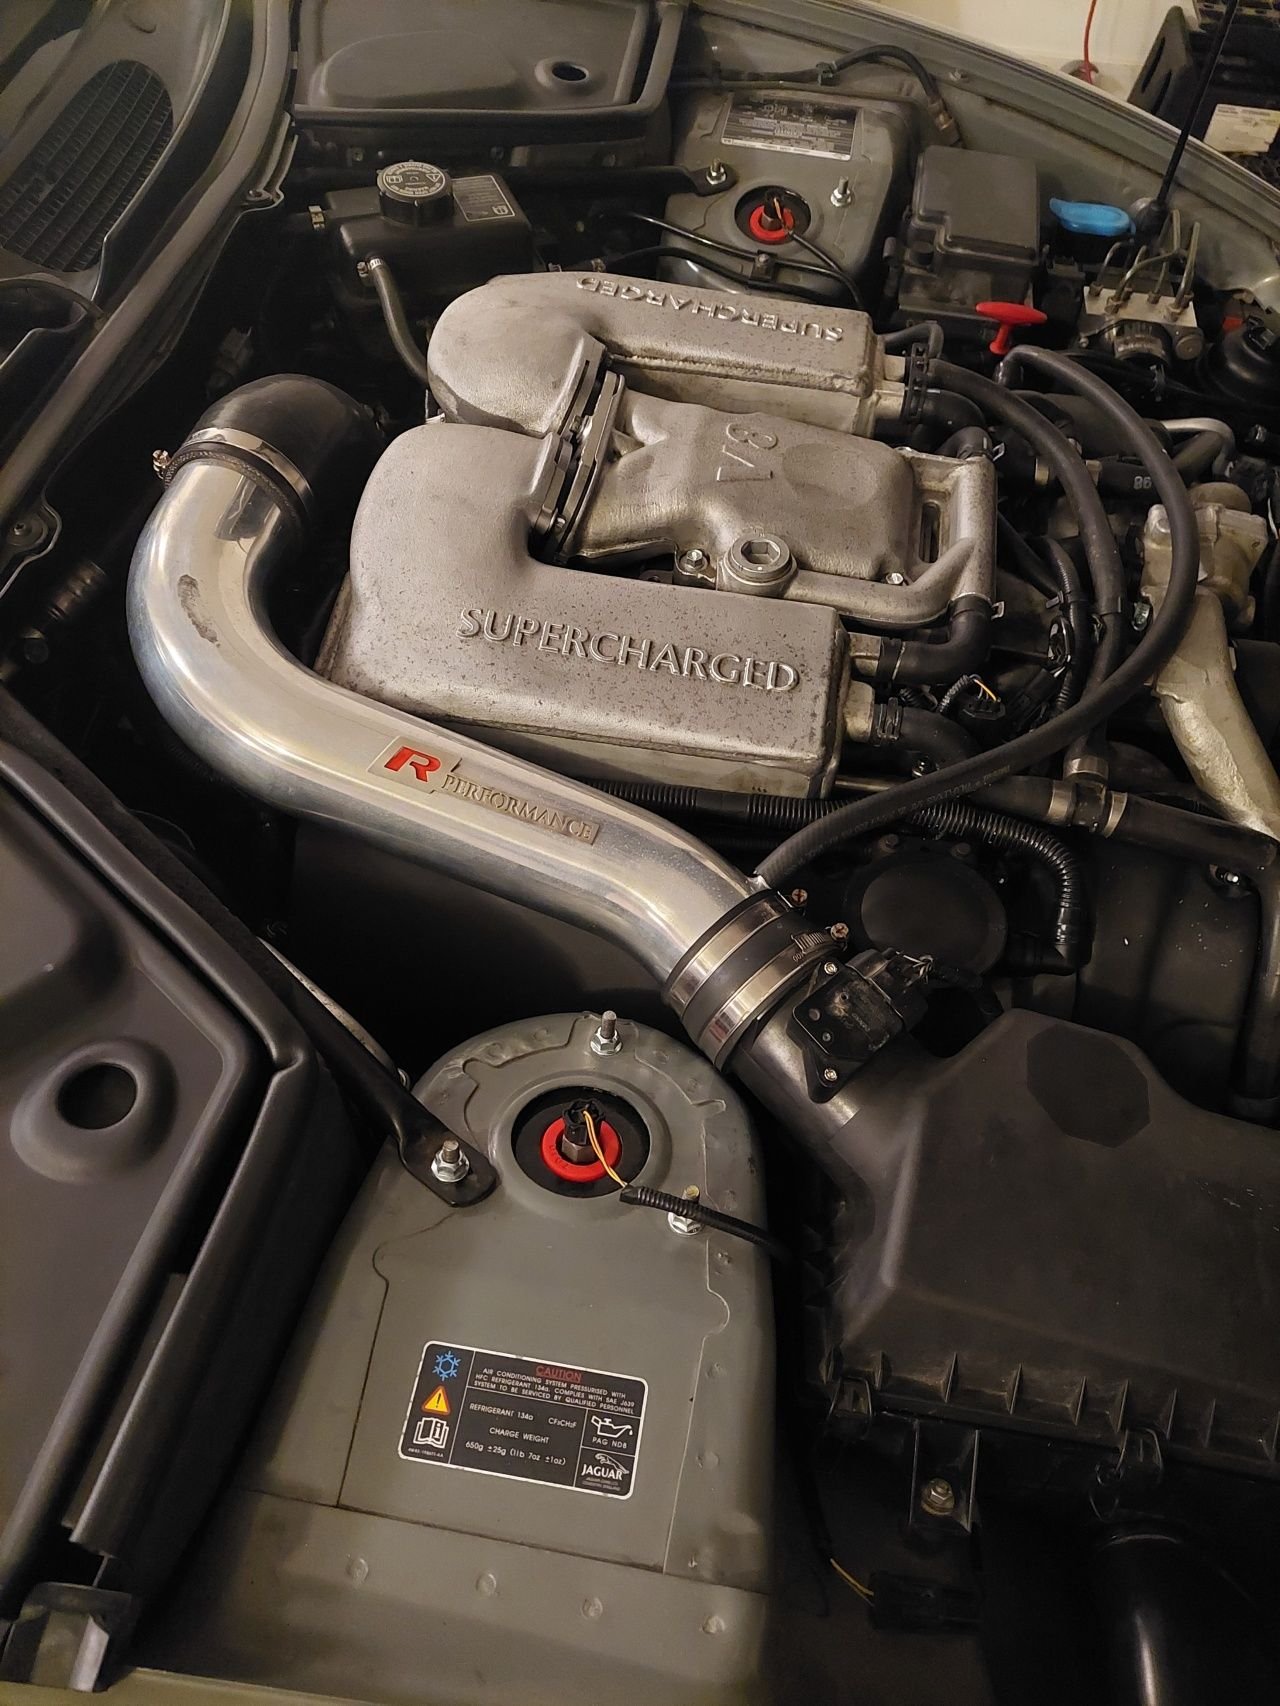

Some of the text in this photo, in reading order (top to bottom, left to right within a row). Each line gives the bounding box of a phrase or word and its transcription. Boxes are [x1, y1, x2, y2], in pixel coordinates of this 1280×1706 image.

[576, 277, 844, 342] SUPERCHARGED
[716, 422, 778, 482] V8
[455, 608, 801, 693] SUPERCHARGED
[384, 745, 594, 841] R PERFORMANCE
[496, 1370, 542, 1384] CONDITIONING
[545, 1379, 567, 1389] SYSTEM
[570, 1384, 608, 1396] PRESSURISED
[611, 1391, 626, 1399] WITH
[536, 1365, 582, 1382] CAUTION
[473, 1380, 634, 1414] SYSTEM TO BE SERVICED BY QUALIFIED PERSONNEL
[491, 1376, 532, 1389] REFRIGERANT
[554, 1387, 585, 1399] COMPLIES
[588, 1394, 603, 1402] WITH
[605, 1397, 618, 1405] SAE
[620, 1400, 635, 1408] J639
[469, 1403, 515, 1417] REFRIGERANT
[517, 1411, 534, 1421] 134a
[489, 1427, 550, 1444] CHARGE WEIGHT
[592, 1436, 609, 1446] PAG
[465, 1441, 484, 1452] 650g
[487, 1444, 507, 1456] ±25g
[528, 1451, 541, 1461] 7oz
[581, 1463, 623, 1481] JAGUAR
